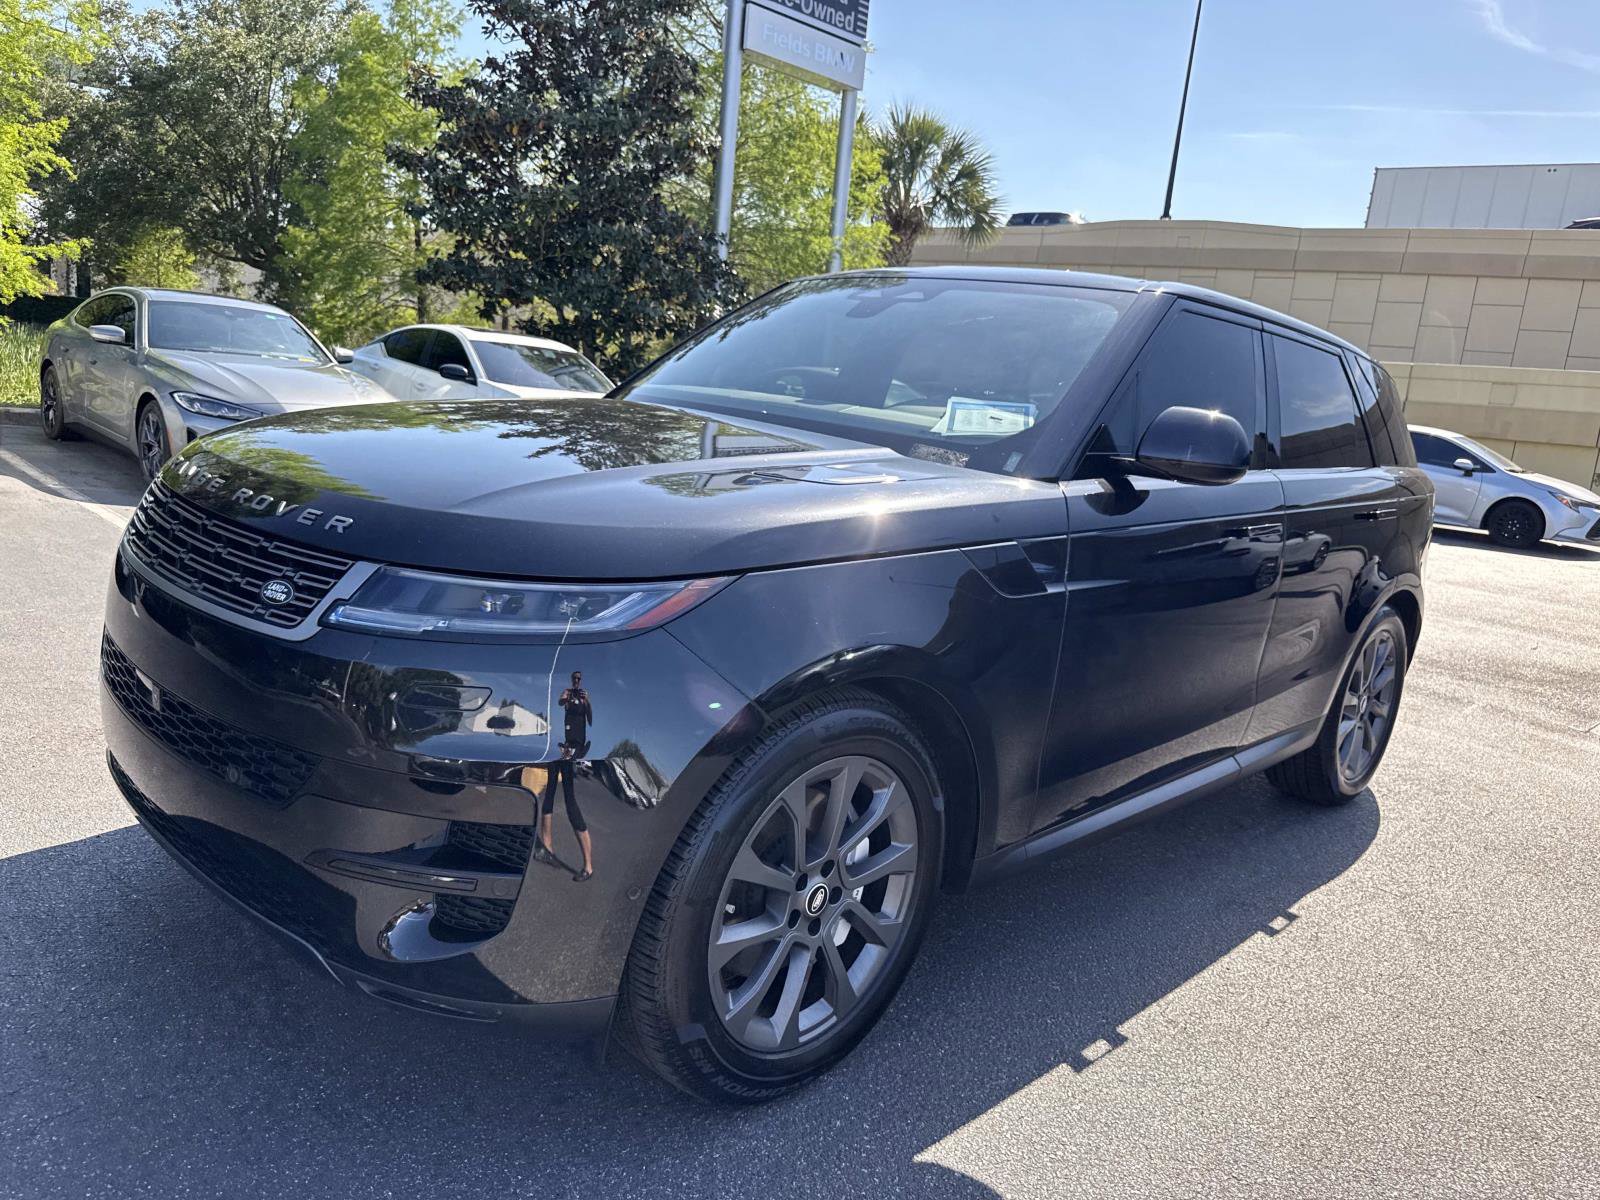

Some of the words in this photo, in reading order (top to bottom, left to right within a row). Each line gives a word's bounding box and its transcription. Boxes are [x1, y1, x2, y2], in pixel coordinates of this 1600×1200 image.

[763, 23, 810, 57] Fields
[815, 43, 855, 73] BMW
[232, 488, 354, 534] ROVER
[265, 589, 287, 602] ROVER
[267, 582, 286, 592] LAND
